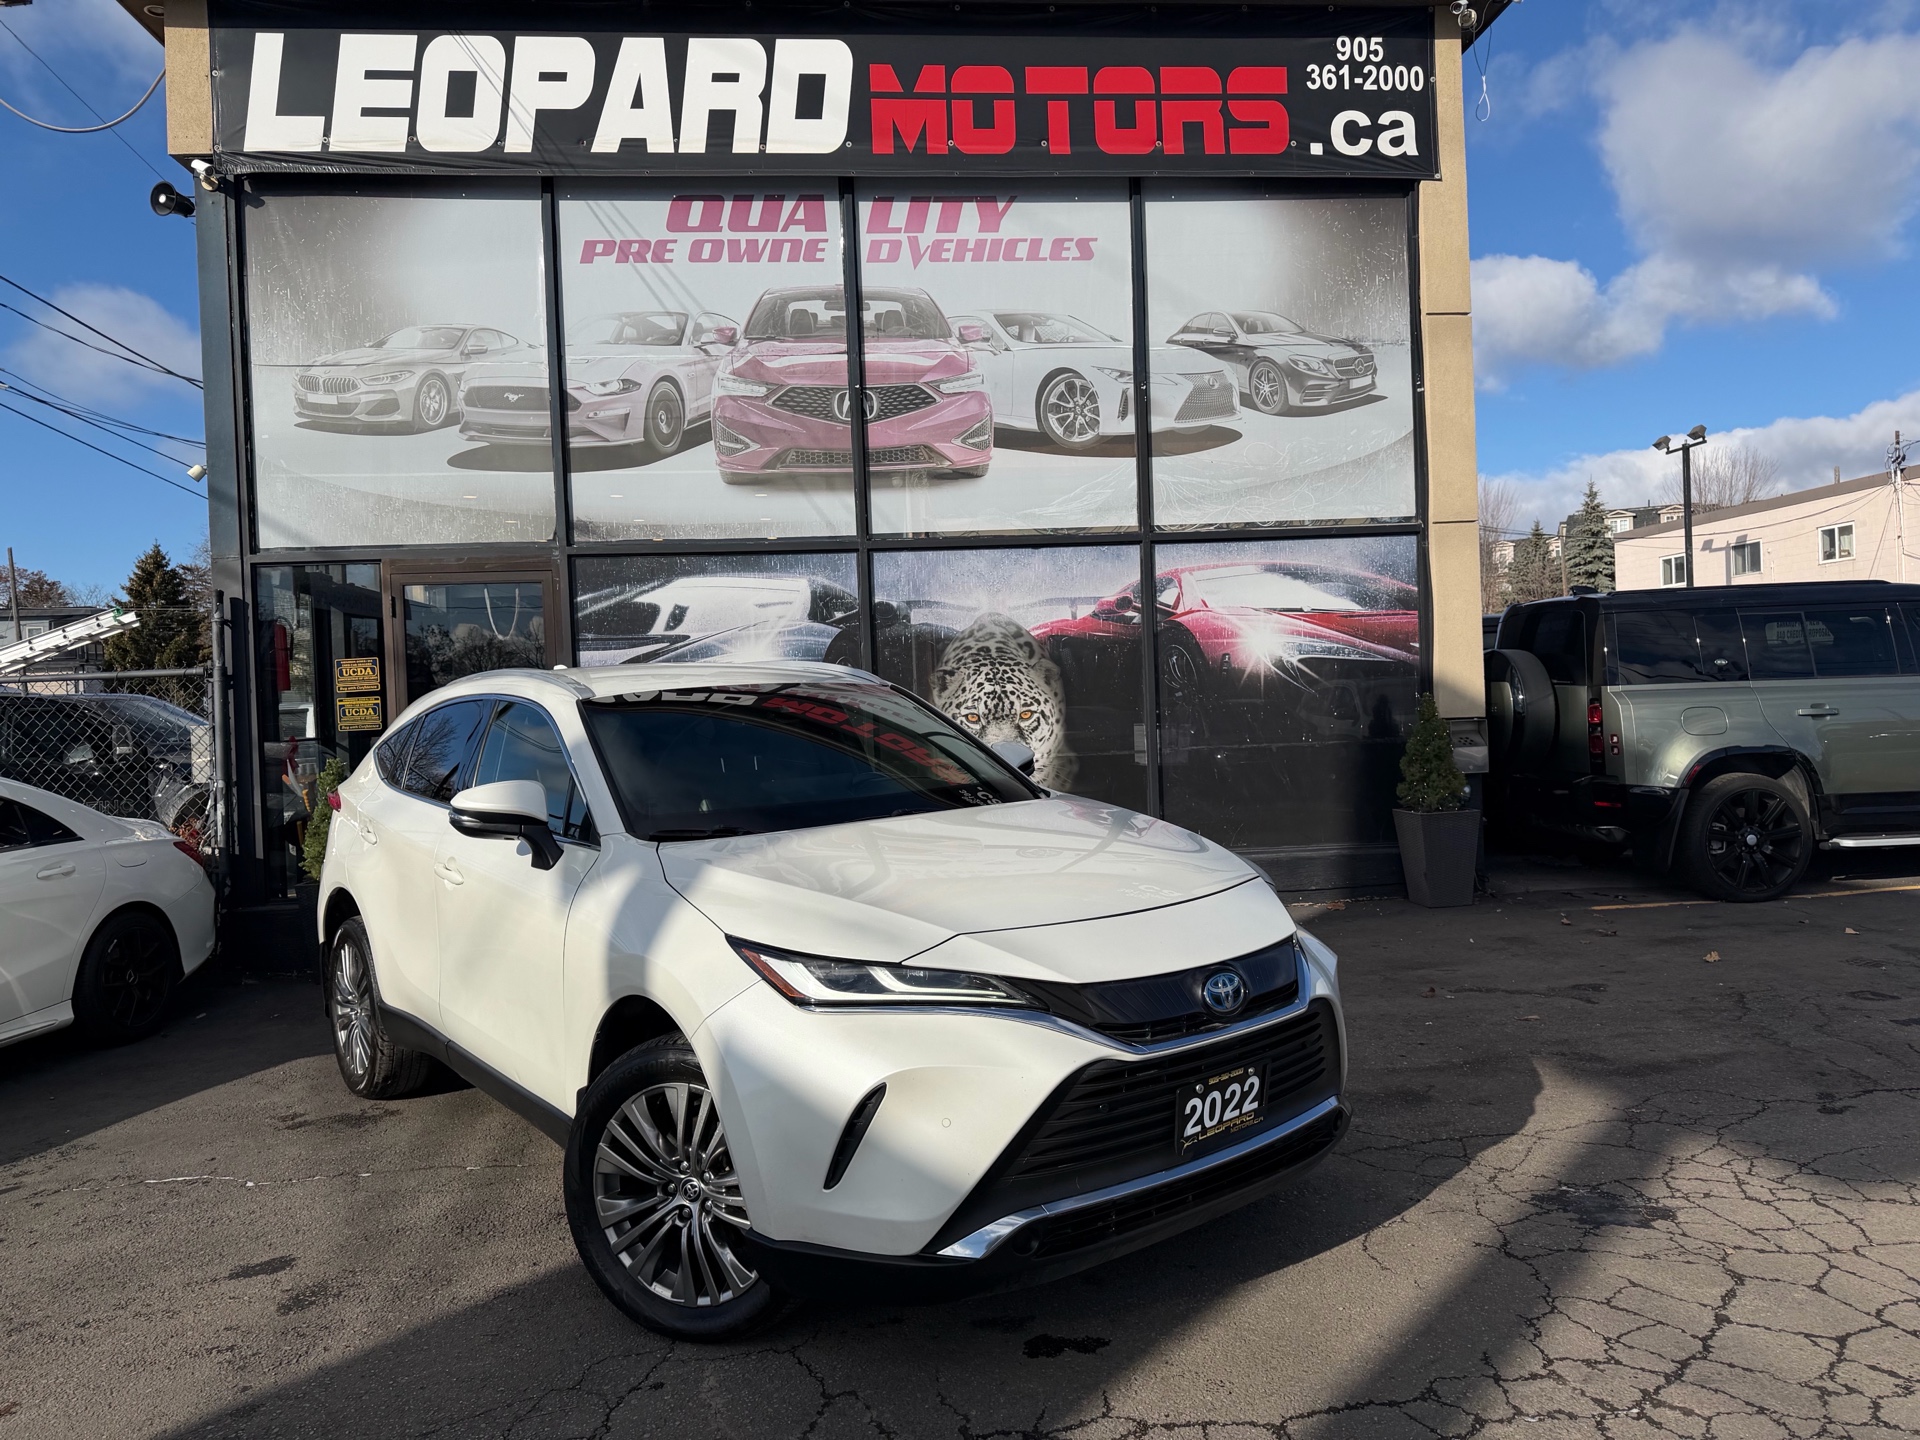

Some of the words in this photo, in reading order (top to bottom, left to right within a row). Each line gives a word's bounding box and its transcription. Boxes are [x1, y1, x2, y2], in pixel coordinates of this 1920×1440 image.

[1335, 36, 1384, 63] 905
[1305, 62, 1425, 93] 361-2000
[243, 32, 854, 155] LEOPARD
[869, 63, 1290, 156] MOTORS
[1308, 109, 1420, 158] .ca
[665, 194, 828, 233] QUA
[865, 195, 1019, 234] LITY
[579, 239, 678, 264] PRE
[342, 668, 373, 677] UCDA
[345, 708, 375, 716] UCDA
[1184, 1075, 1259, 1137] 2022
[1198, 1111, 1255, 1140] LEOPARD
